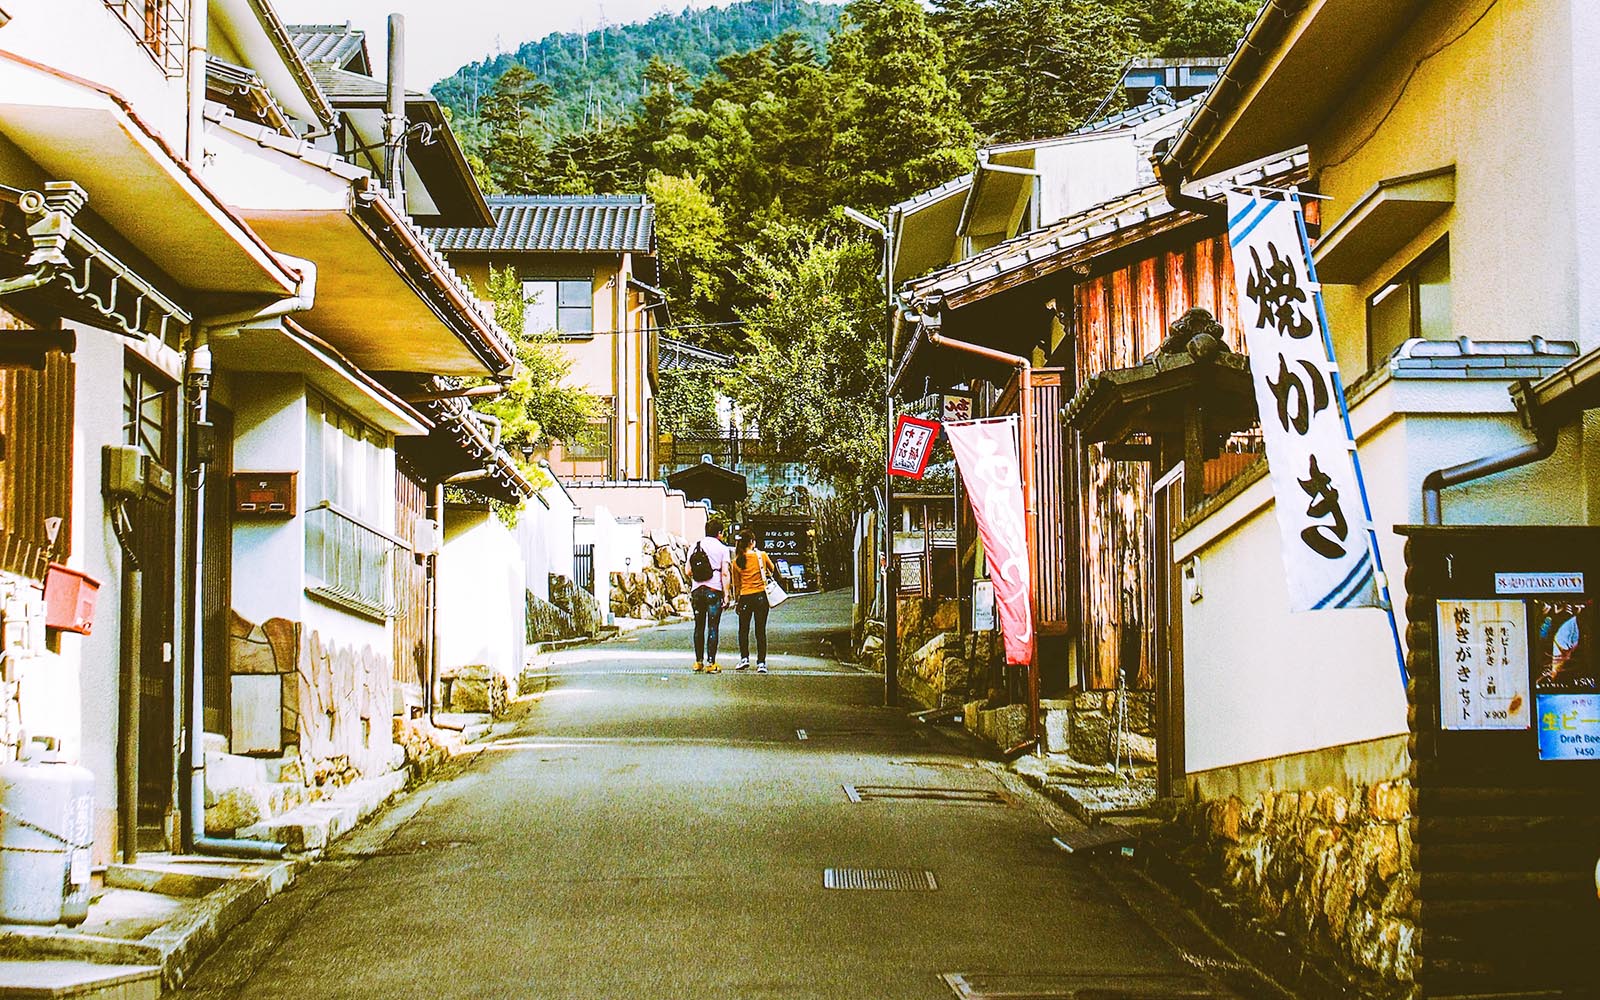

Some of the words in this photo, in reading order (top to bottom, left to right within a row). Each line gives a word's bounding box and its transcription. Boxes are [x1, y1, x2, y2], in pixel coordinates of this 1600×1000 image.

[1246, 241, 1347, 559] 焼かき
[1453, 607, 1472, 720] 焼きがきセット
[1560, 734, 1582, 744] Draft
[1574, 747, 1595, 756] ¥450
